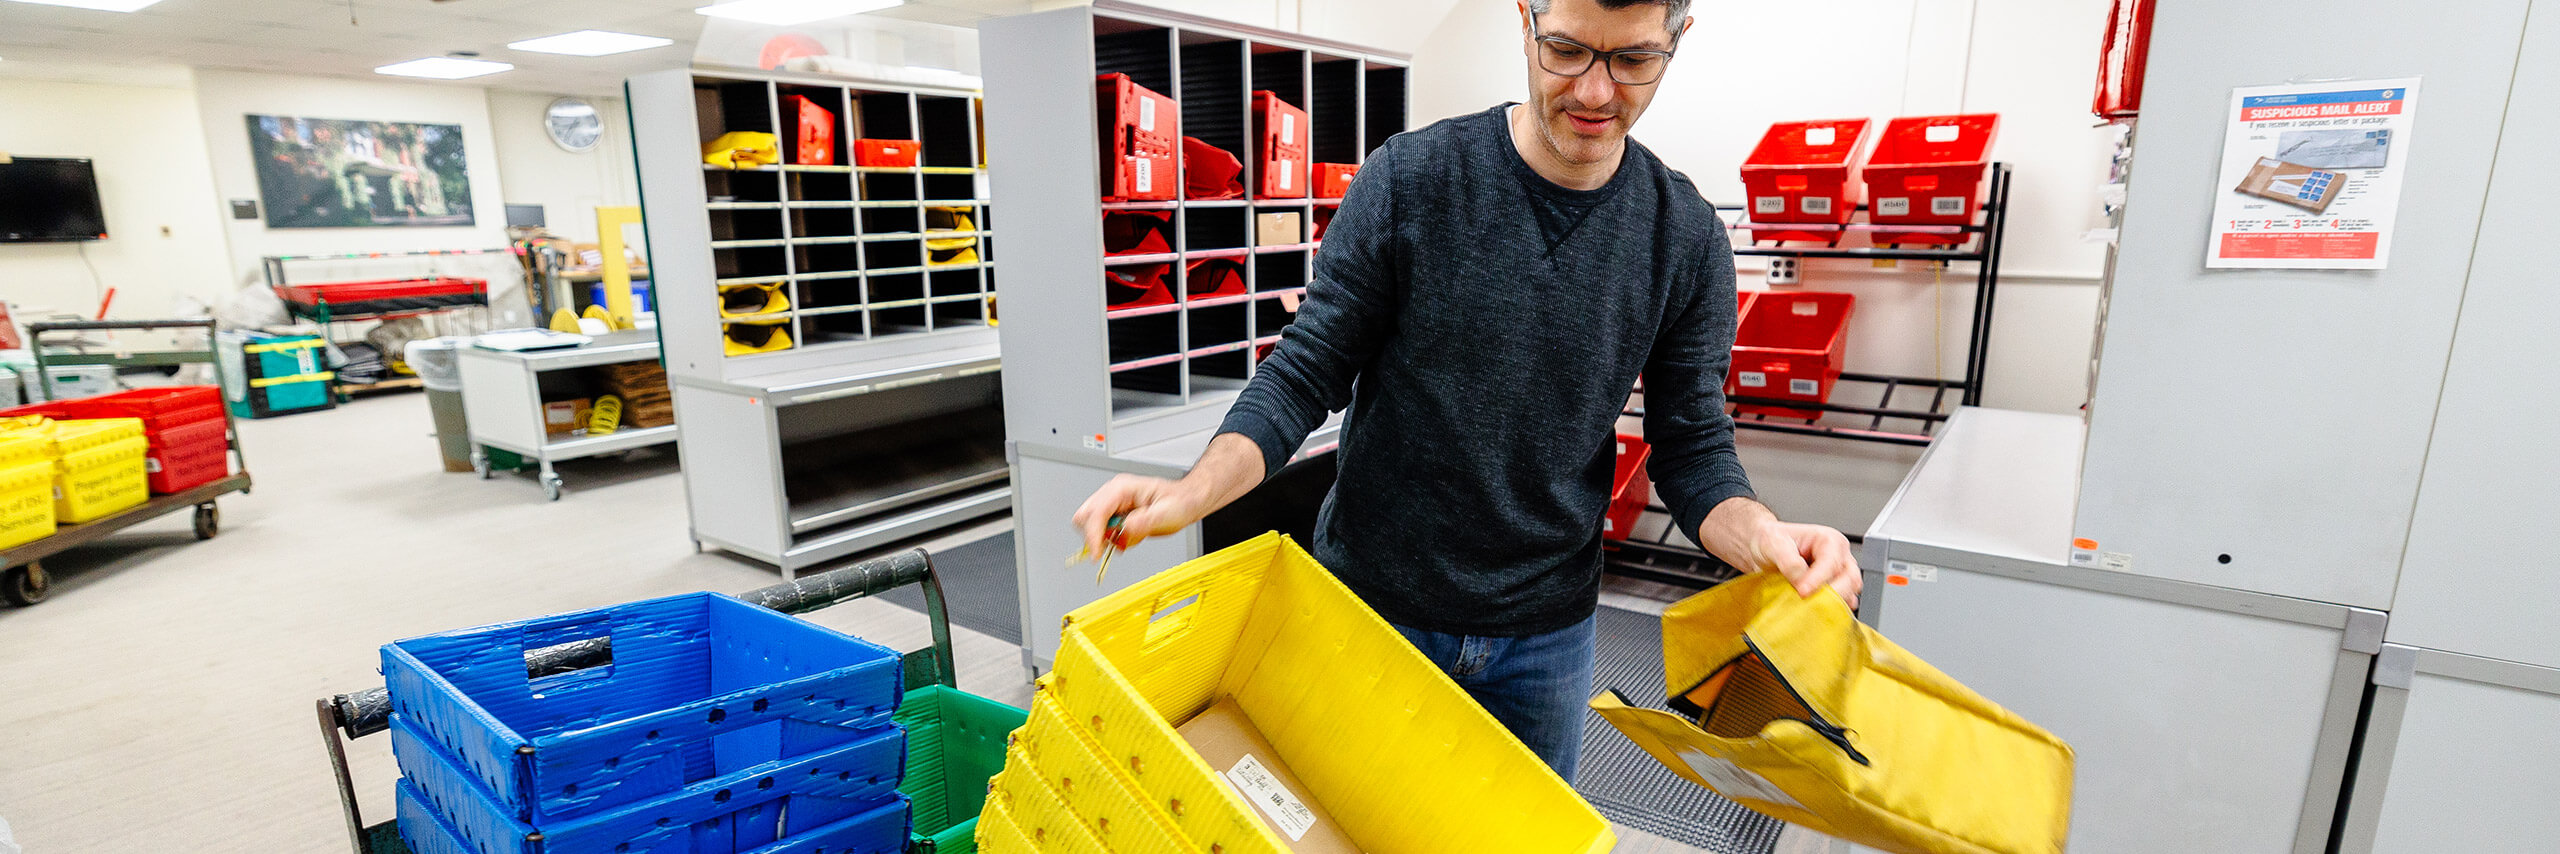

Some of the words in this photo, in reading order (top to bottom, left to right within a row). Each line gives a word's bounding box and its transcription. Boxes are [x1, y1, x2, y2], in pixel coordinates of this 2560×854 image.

[2250, 106, 2319, 119] SUSPICIOUS
[2320, 104, 2350, 116] MAIL
[2353, 102, 2391, 114] ALERT
[2299, 119, 2330, 128] suspicious
[2229, 220, 2236, 229] 1
[2264, 219, 2272, 229] 2
[2293, 219, 2301, 229] 3
[2330, 219, 2339, 229] 4
